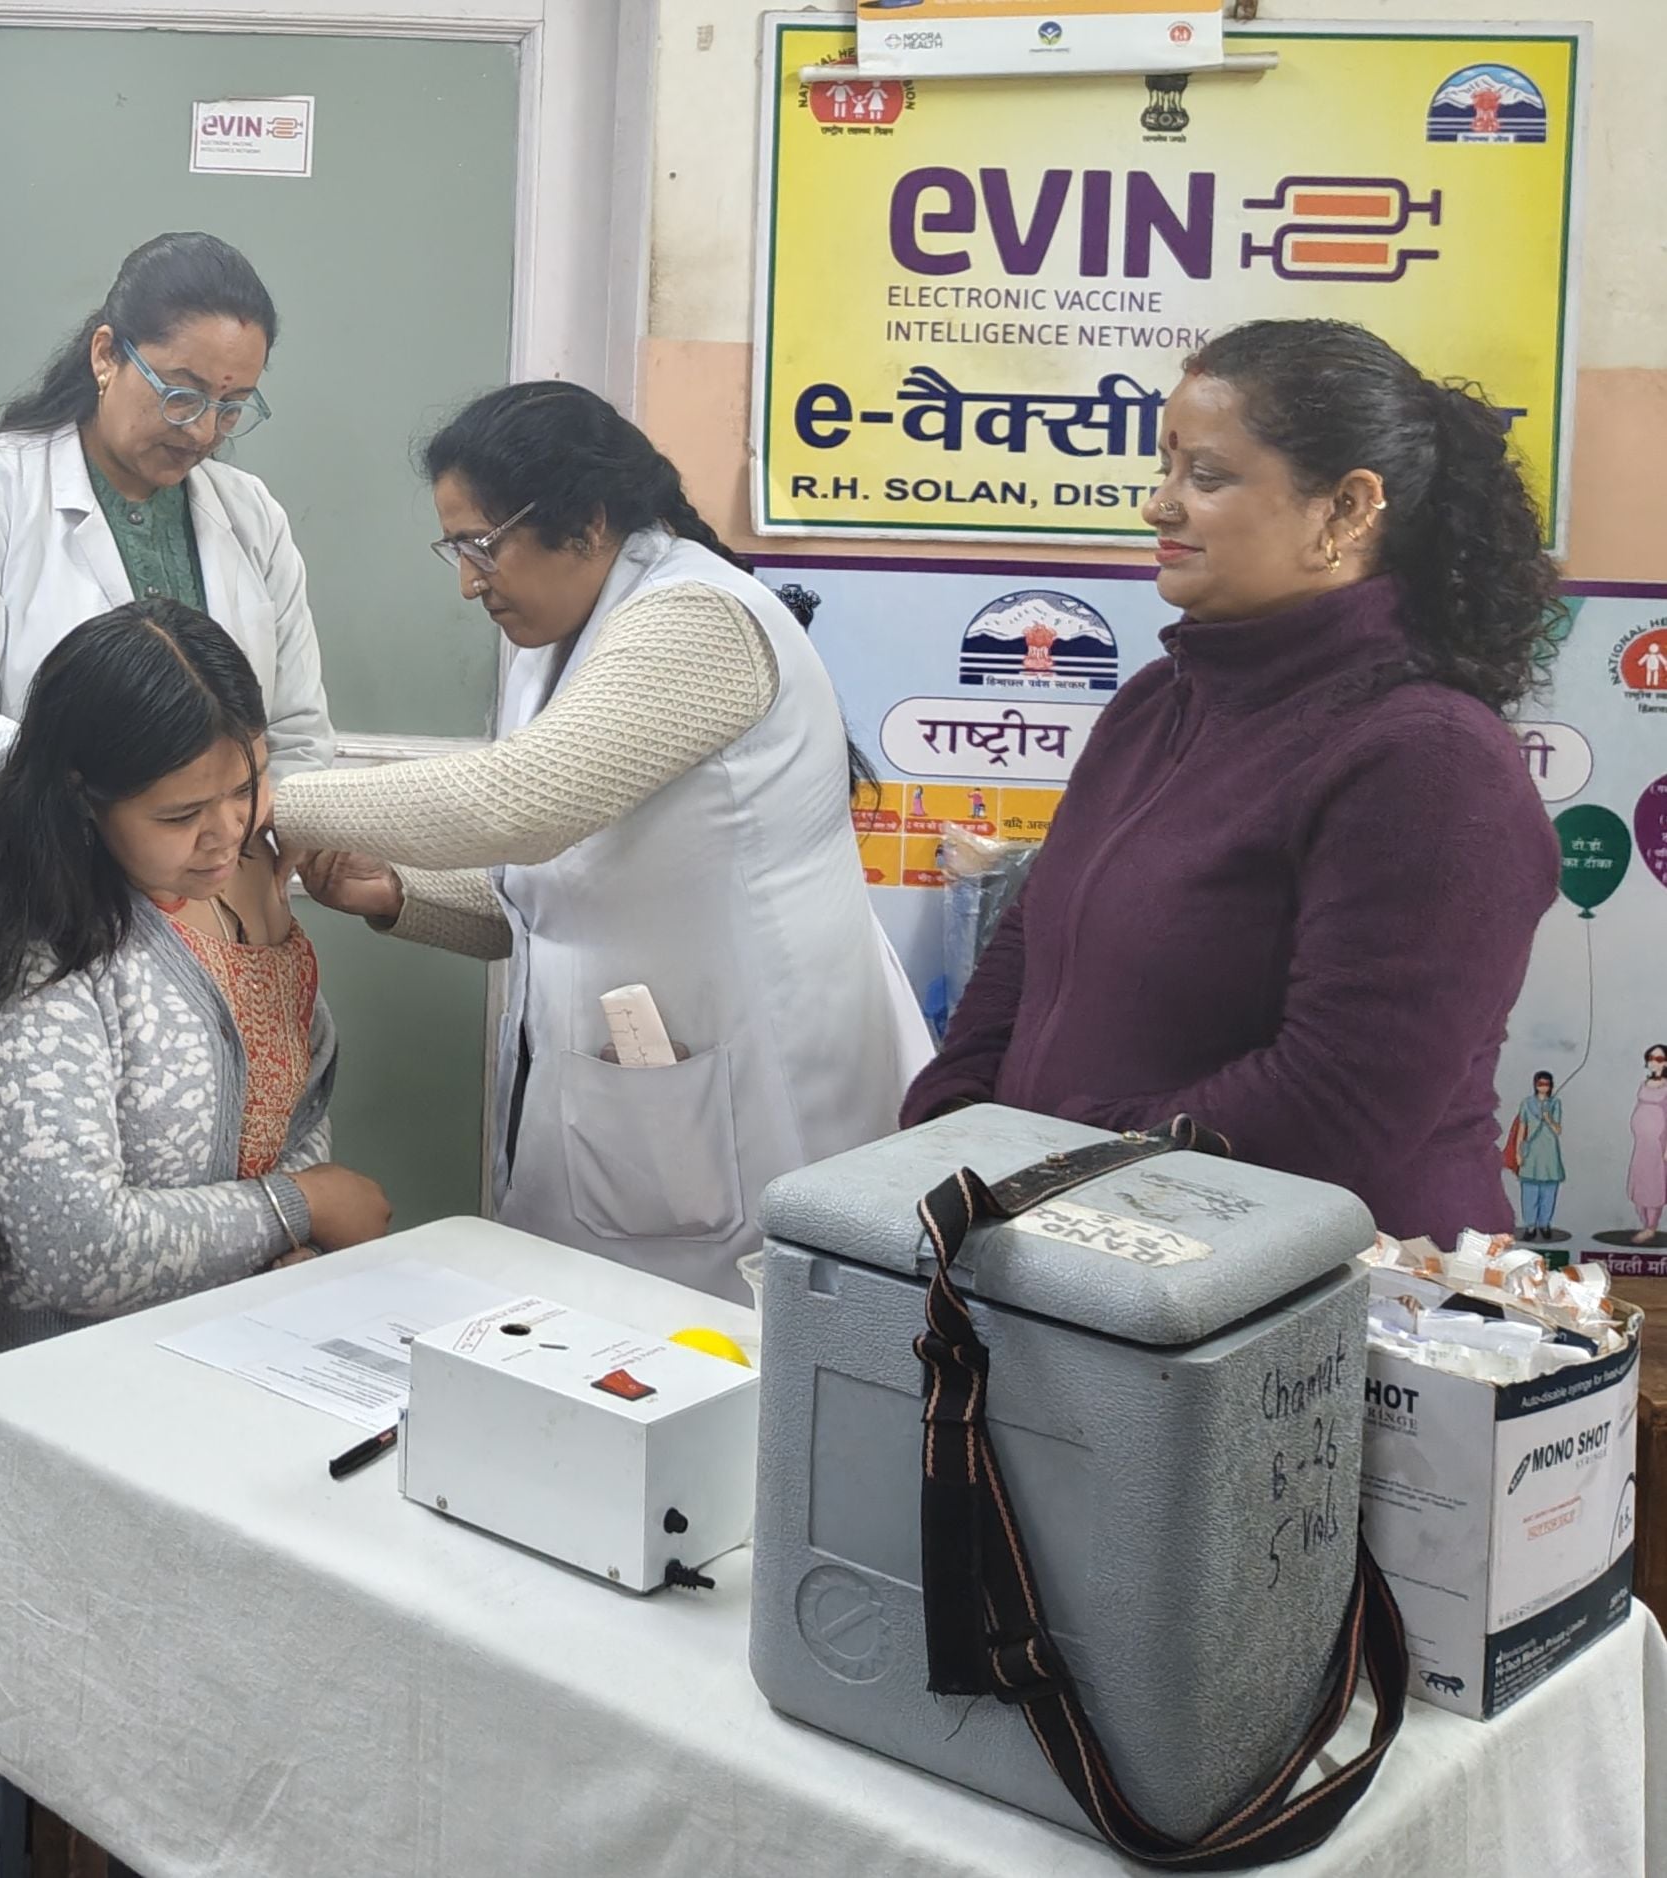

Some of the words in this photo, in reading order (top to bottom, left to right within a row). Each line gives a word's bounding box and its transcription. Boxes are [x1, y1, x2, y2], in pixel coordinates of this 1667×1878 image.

[903, 40, 943, 50] HEALTH
[887, 285, 1047, 310] ELECTRONIC
[1054, 289, 1162, 313] VACCINE
[886, 320, 1069, 346] INTELLIGENCE
[1078, 325, 1212, 350] NETWORK
[794, 365, 1168, 457] e-वैक्सी
[791, 475, 869, 500] R.H.
[884, 478, 1038, 509] SOLAN,
[917, 709, 1071, 767] राष्ट्रीय
[1365, 1377, 1419, 1413] HOT
[1368, 1407, 1418, 1430] RINGE
[1532, 1437, 1574, 1473] MONO
[1578, 1420, 1611, 1456] SHOT
